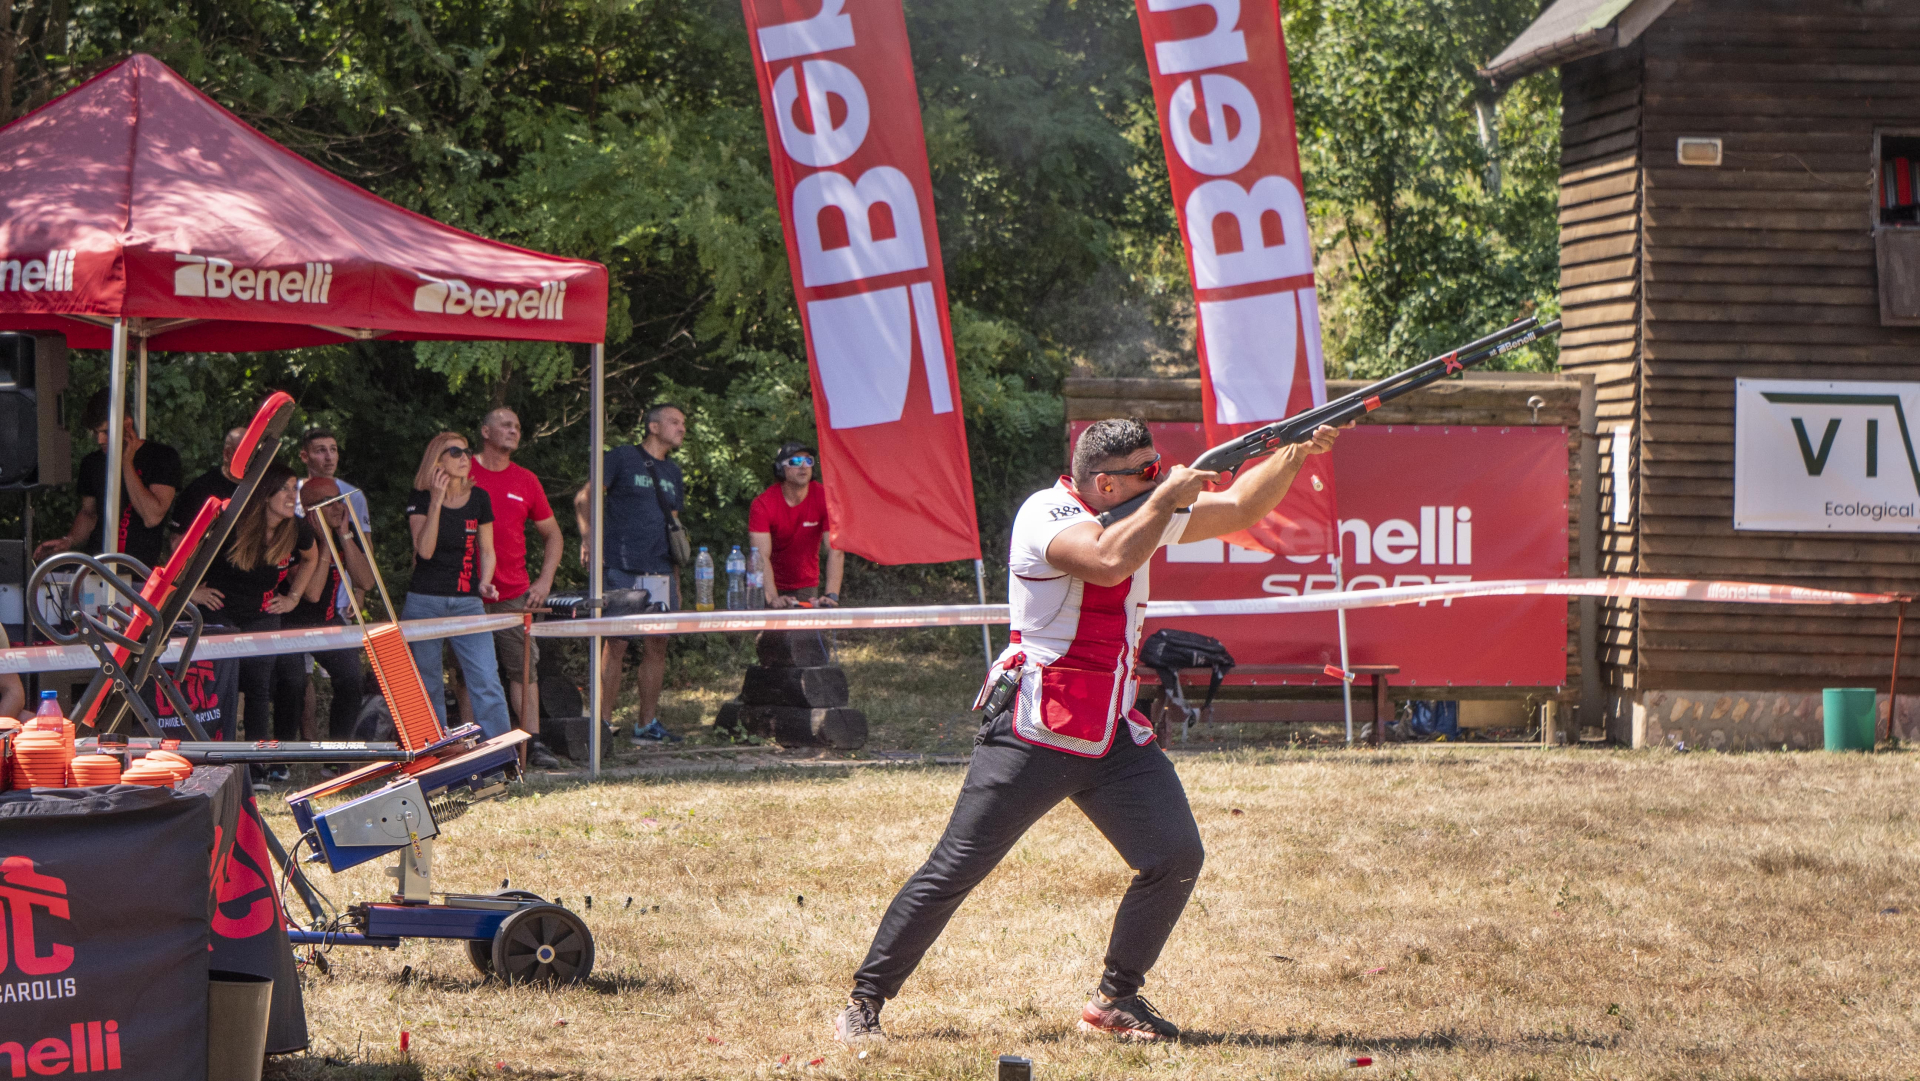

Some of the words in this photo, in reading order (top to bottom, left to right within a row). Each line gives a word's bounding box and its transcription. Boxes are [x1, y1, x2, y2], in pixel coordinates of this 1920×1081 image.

[206, 257, 333, 304] Benelli
[446, 279, 567, 320] Benelli
[1825, 501, 1914, 521] Ecological
